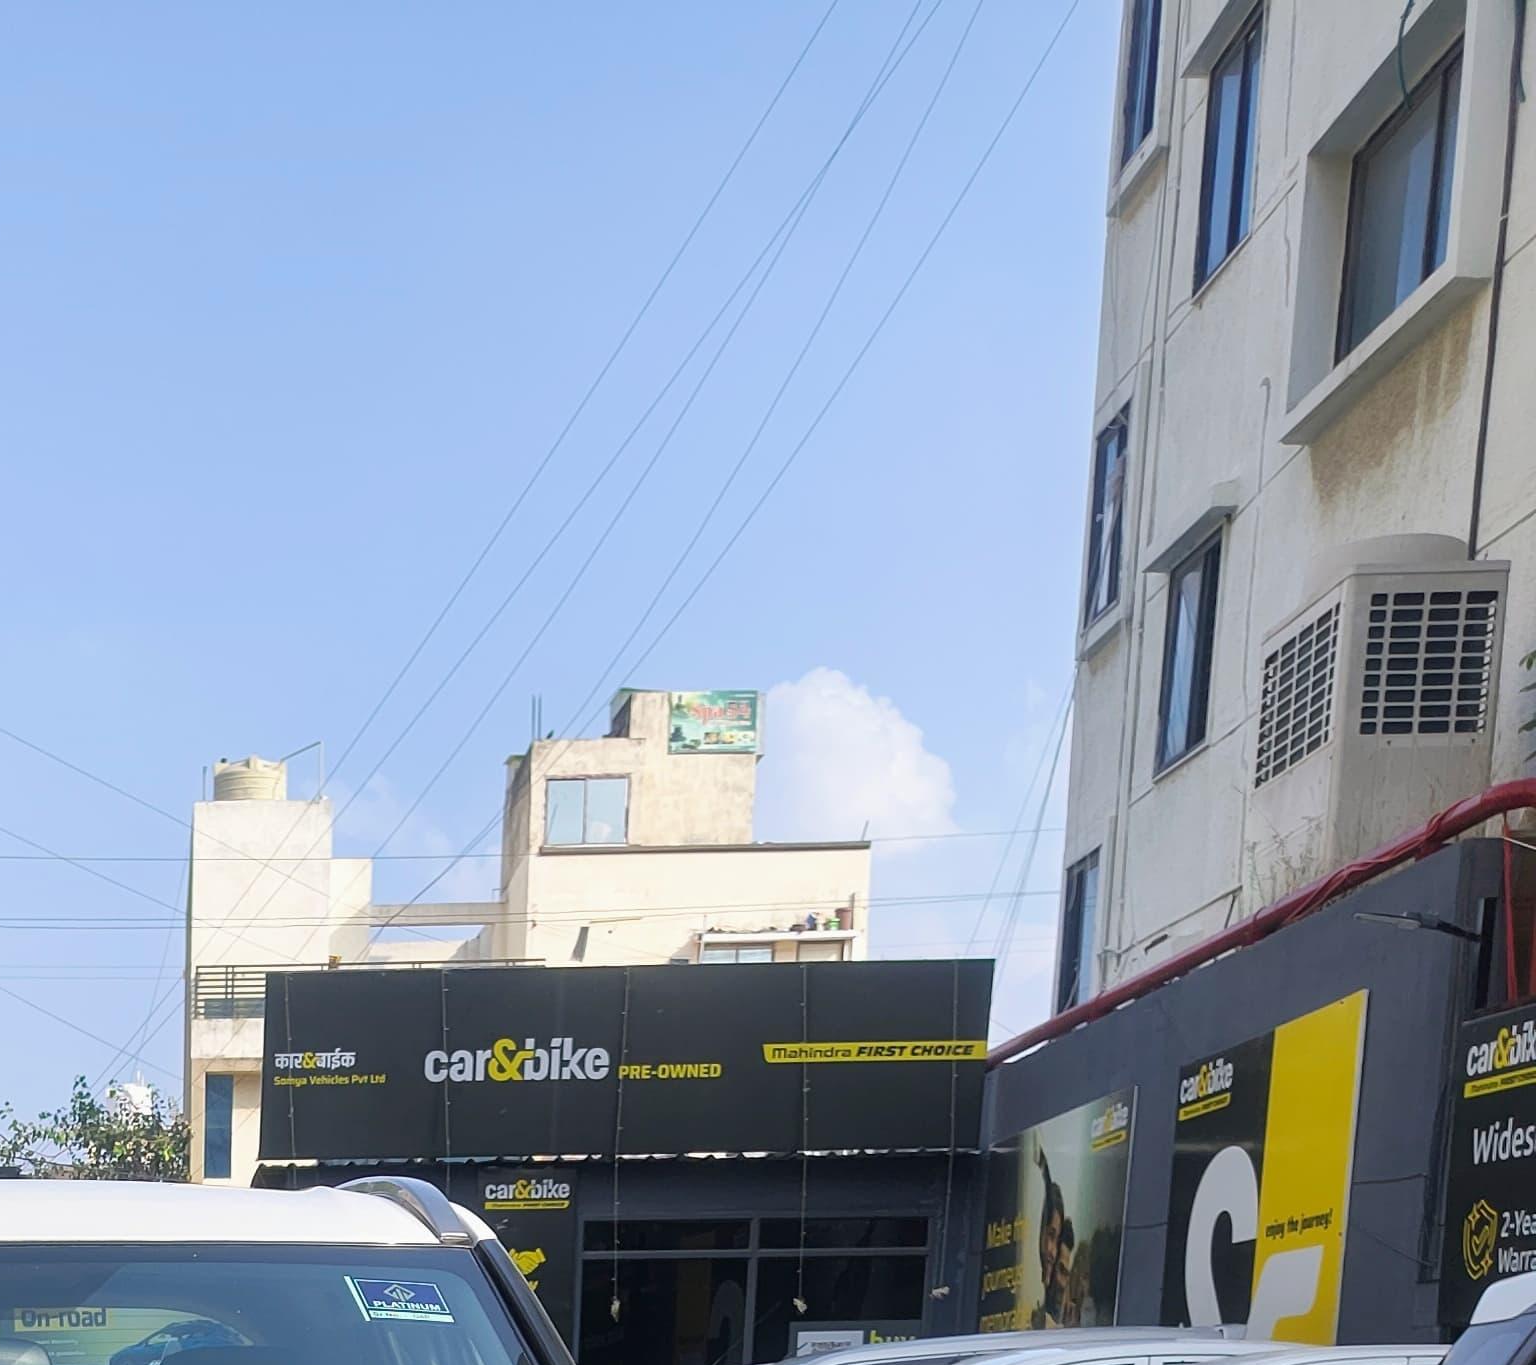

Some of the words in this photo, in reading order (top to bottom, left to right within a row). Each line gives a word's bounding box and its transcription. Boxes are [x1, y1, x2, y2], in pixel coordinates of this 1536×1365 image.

[772, 1047, 851, 1059] Mahindra
[856, 1045, 907, 1057] FIRST
[910, 1044, 975, 1056] CHOICE
[1466, 1020, 1536, 1077] car&bik
[424, 1037, 610, 1083] car&bike
[618, 1063, 722, 1080] PRE-OWNED
[370, 1073, 386, 1084] Ltd
[1180, 1058, 1233, 1104] car&bike
[1473, 1117, 1536, 1165] Wides
[485, 1179, 570, 1199] car&bike
[372, 1300, 441, 1312] PLATINUM
[21, 1308, 107, 1328] On-road
